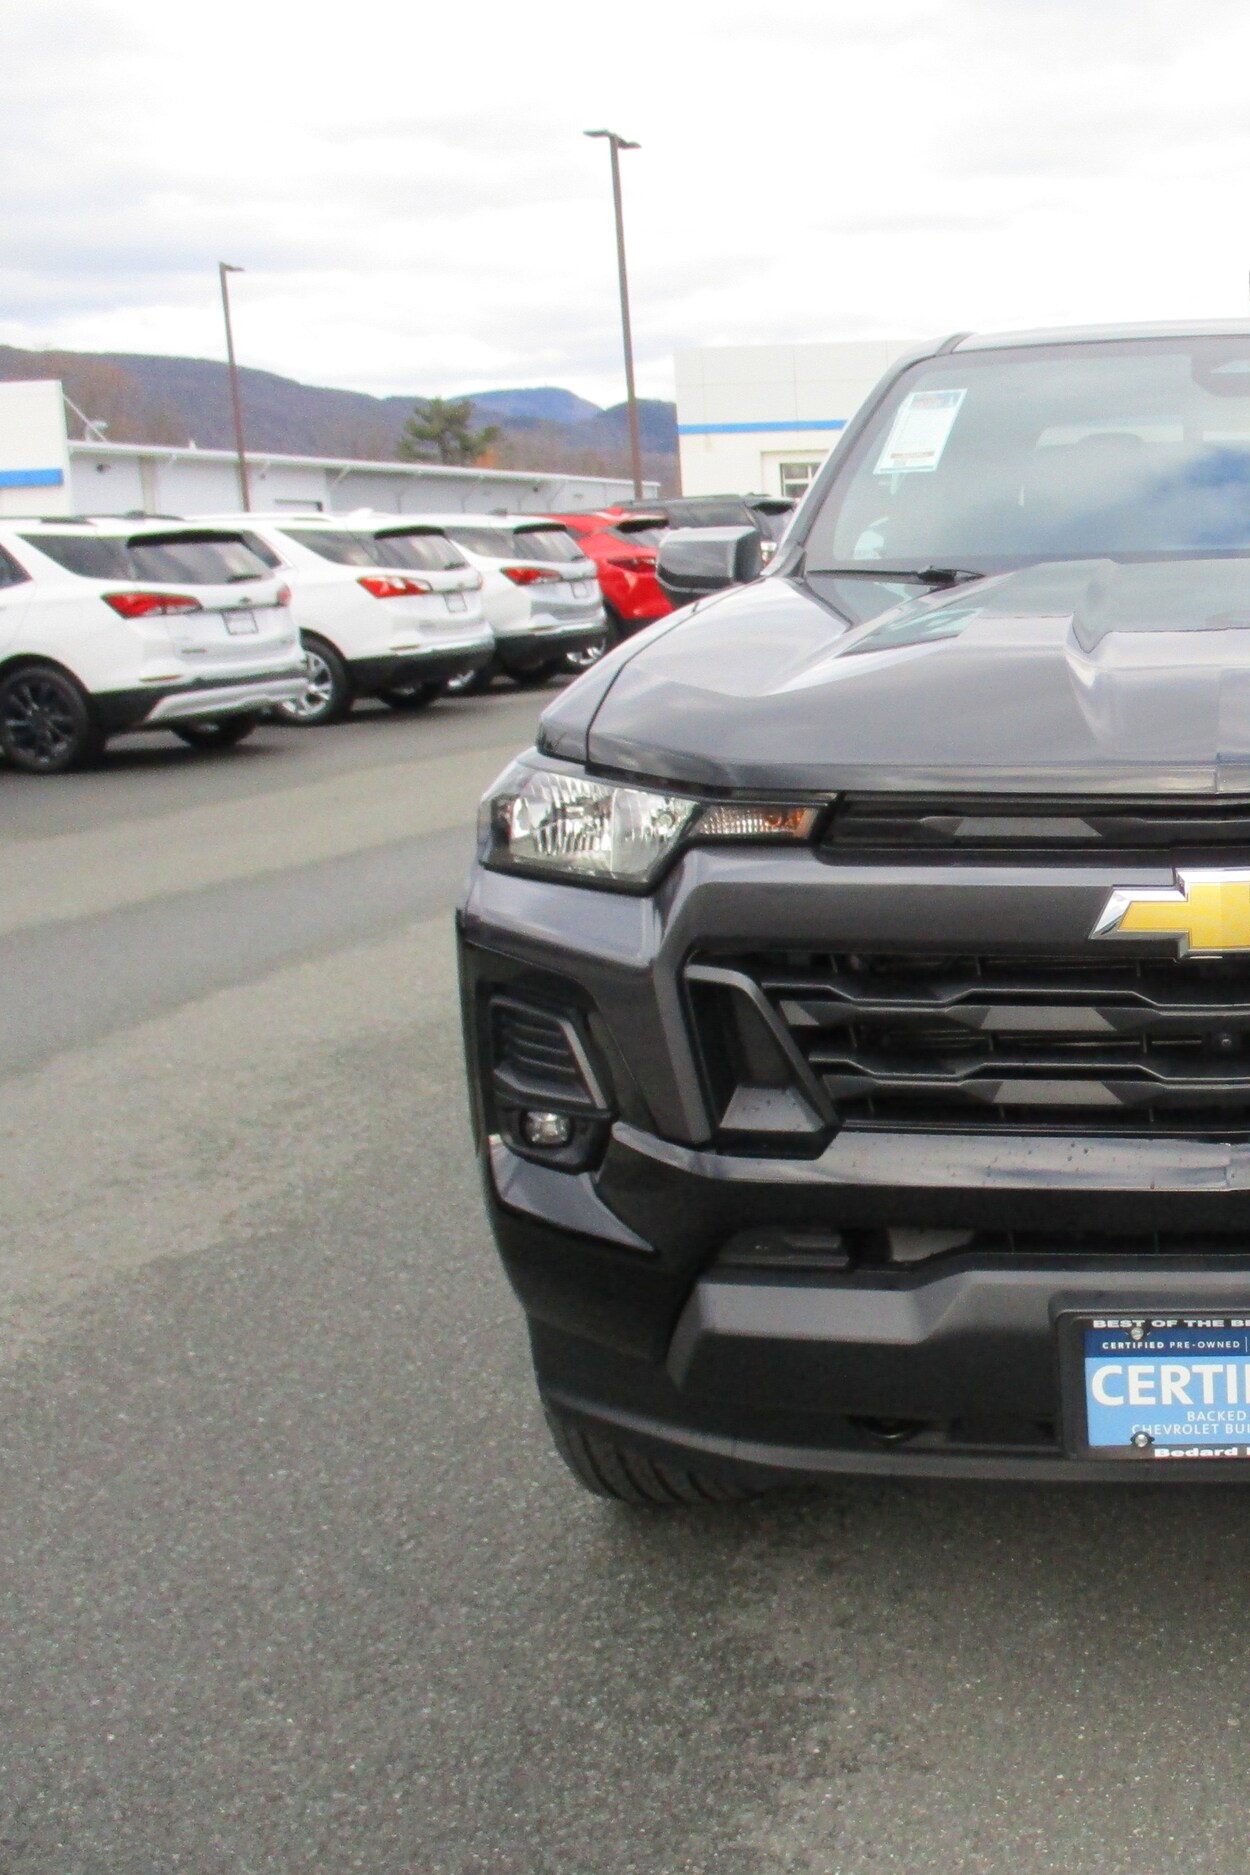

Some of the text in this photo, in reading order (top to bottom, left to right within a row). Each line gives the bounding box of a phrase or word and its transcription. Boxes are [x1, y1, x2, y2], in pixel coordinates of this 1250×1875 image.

[1093, 1319, 1145, 1328] BEST
[1152, 1319, 1177, 1327] OF
[1184, 1319, 1224, 1328] THE
[1102, 1341, 1164, 1349] CERTIFIED
[1187, 1410, 1247, 1422] BACKED
[1132, 1423, 1219, 1435] CHEVROLET
[1154, 1447, 1238, 1457] Bedard
